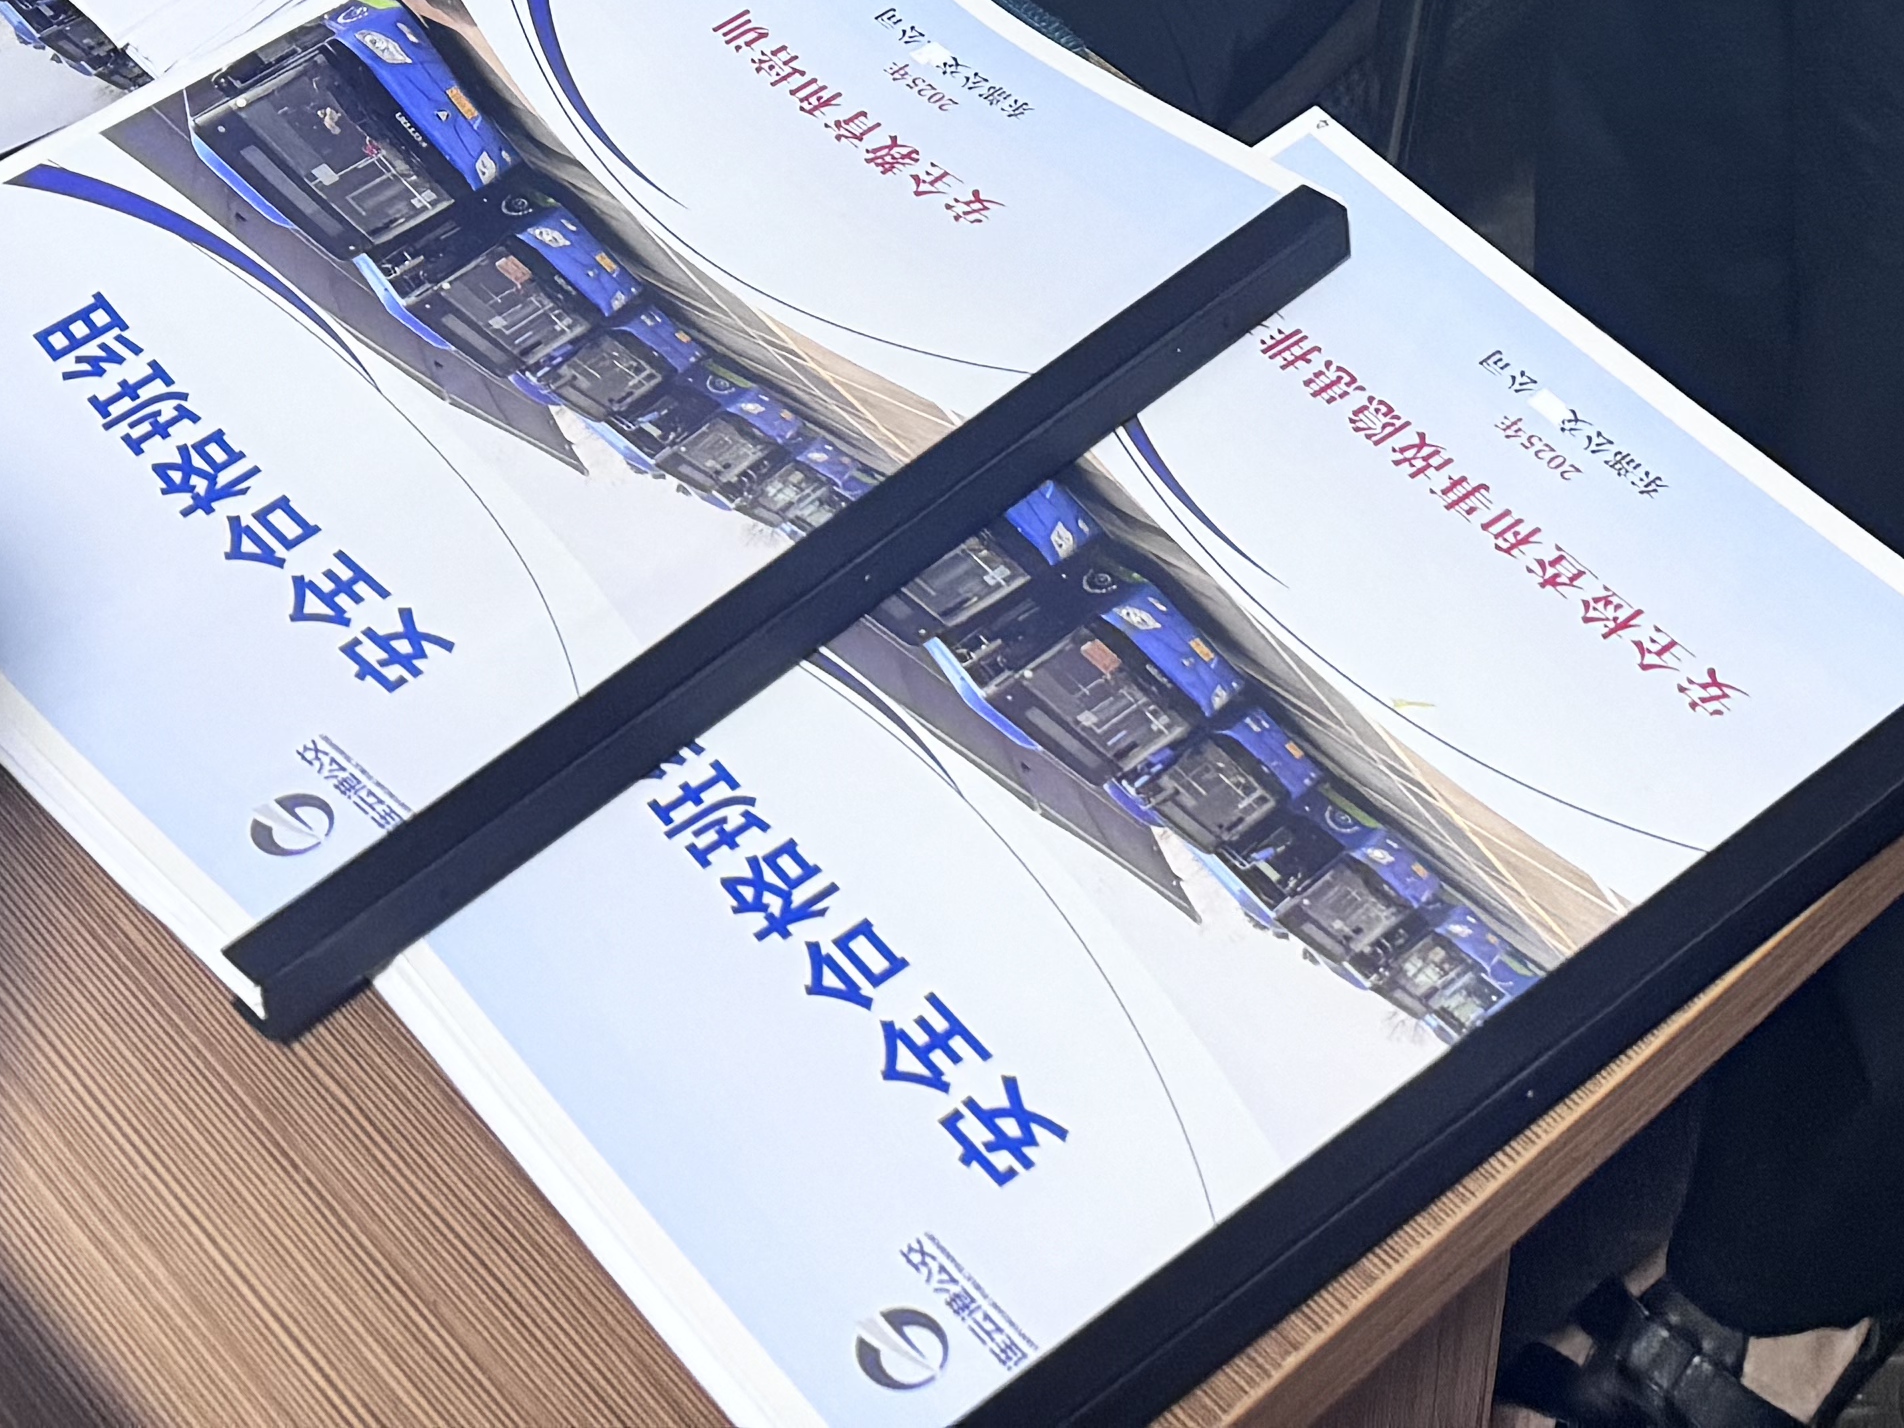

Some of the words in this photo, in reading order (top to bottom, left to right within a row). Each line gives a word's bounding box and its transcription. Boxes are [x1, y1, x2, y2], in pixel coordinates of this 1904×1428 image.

[712, 8, 1007, 225] 安全教育和培训
[882, 60, 960, 112] 2025年
[32, 292, 456, 694] 安全合格班组
[1246, 306, 1751, 718] 安全检查和事故隐患排
[1494, 414, 1584, 483] 2025年
[899, 1237, 1026, 1370] 连云港公交
